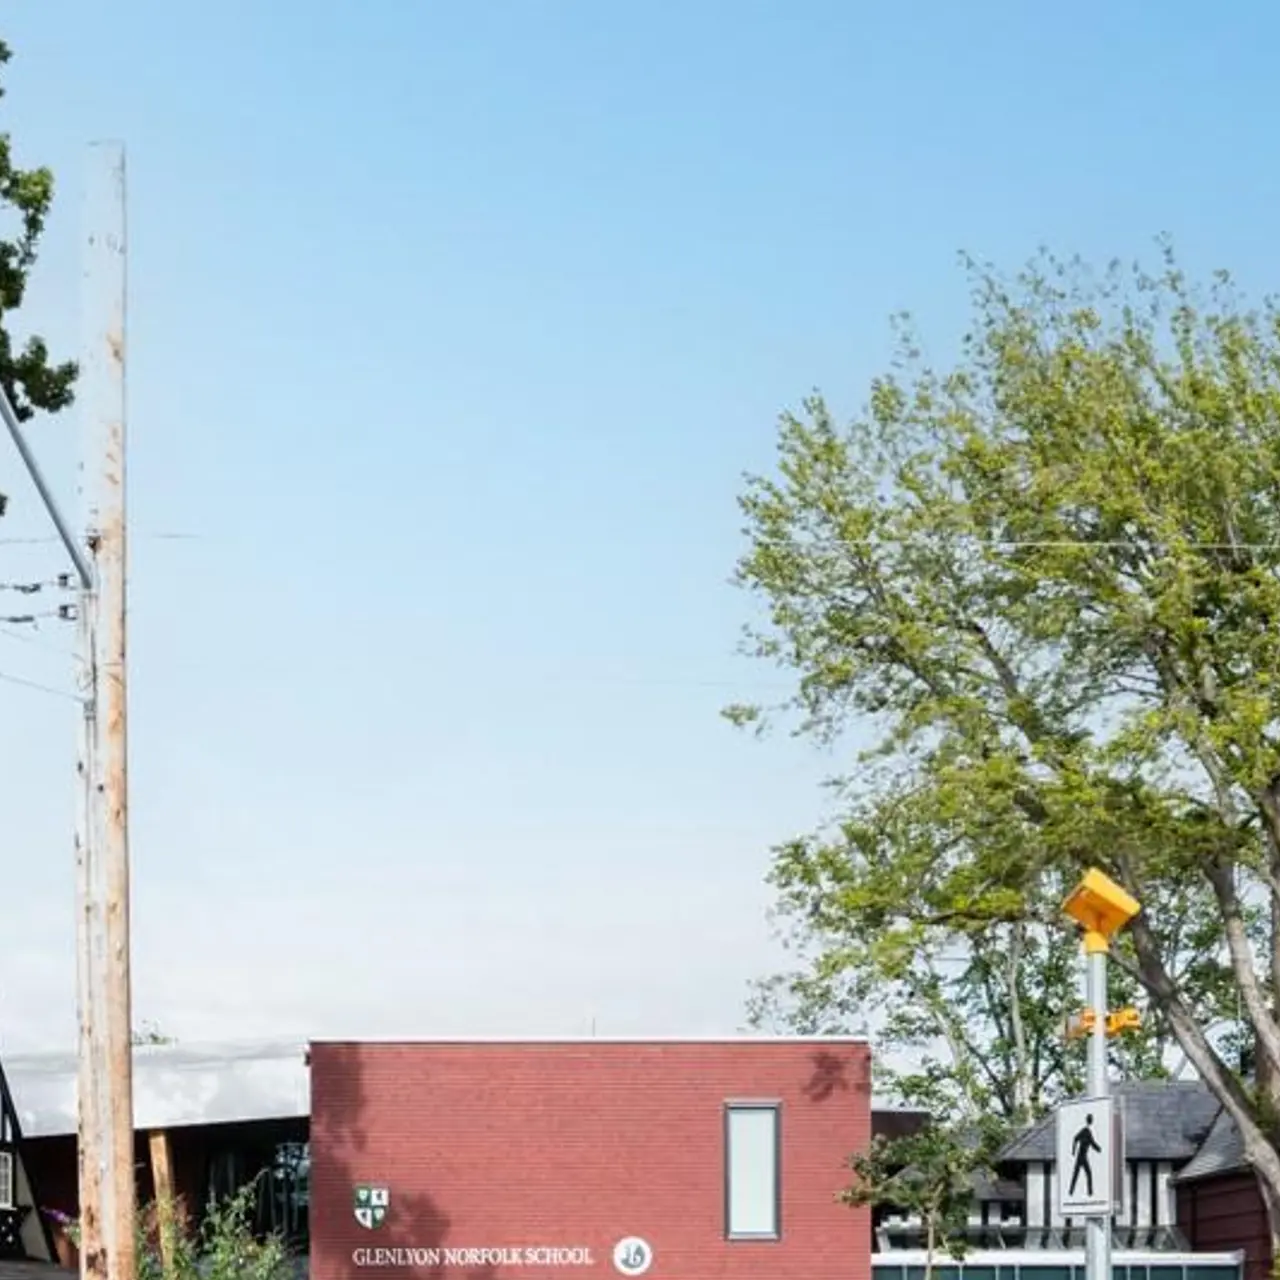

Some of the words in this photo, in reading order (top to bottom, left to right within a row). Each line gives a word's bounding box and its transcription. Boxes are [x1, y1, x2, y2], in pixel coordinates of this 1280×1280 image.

[352, 1247, 440, 1266] GLENLYON
[444, 1247, 522, 1266] NORFOLK
[524, 1247, 594, 1266] SCHOOL
